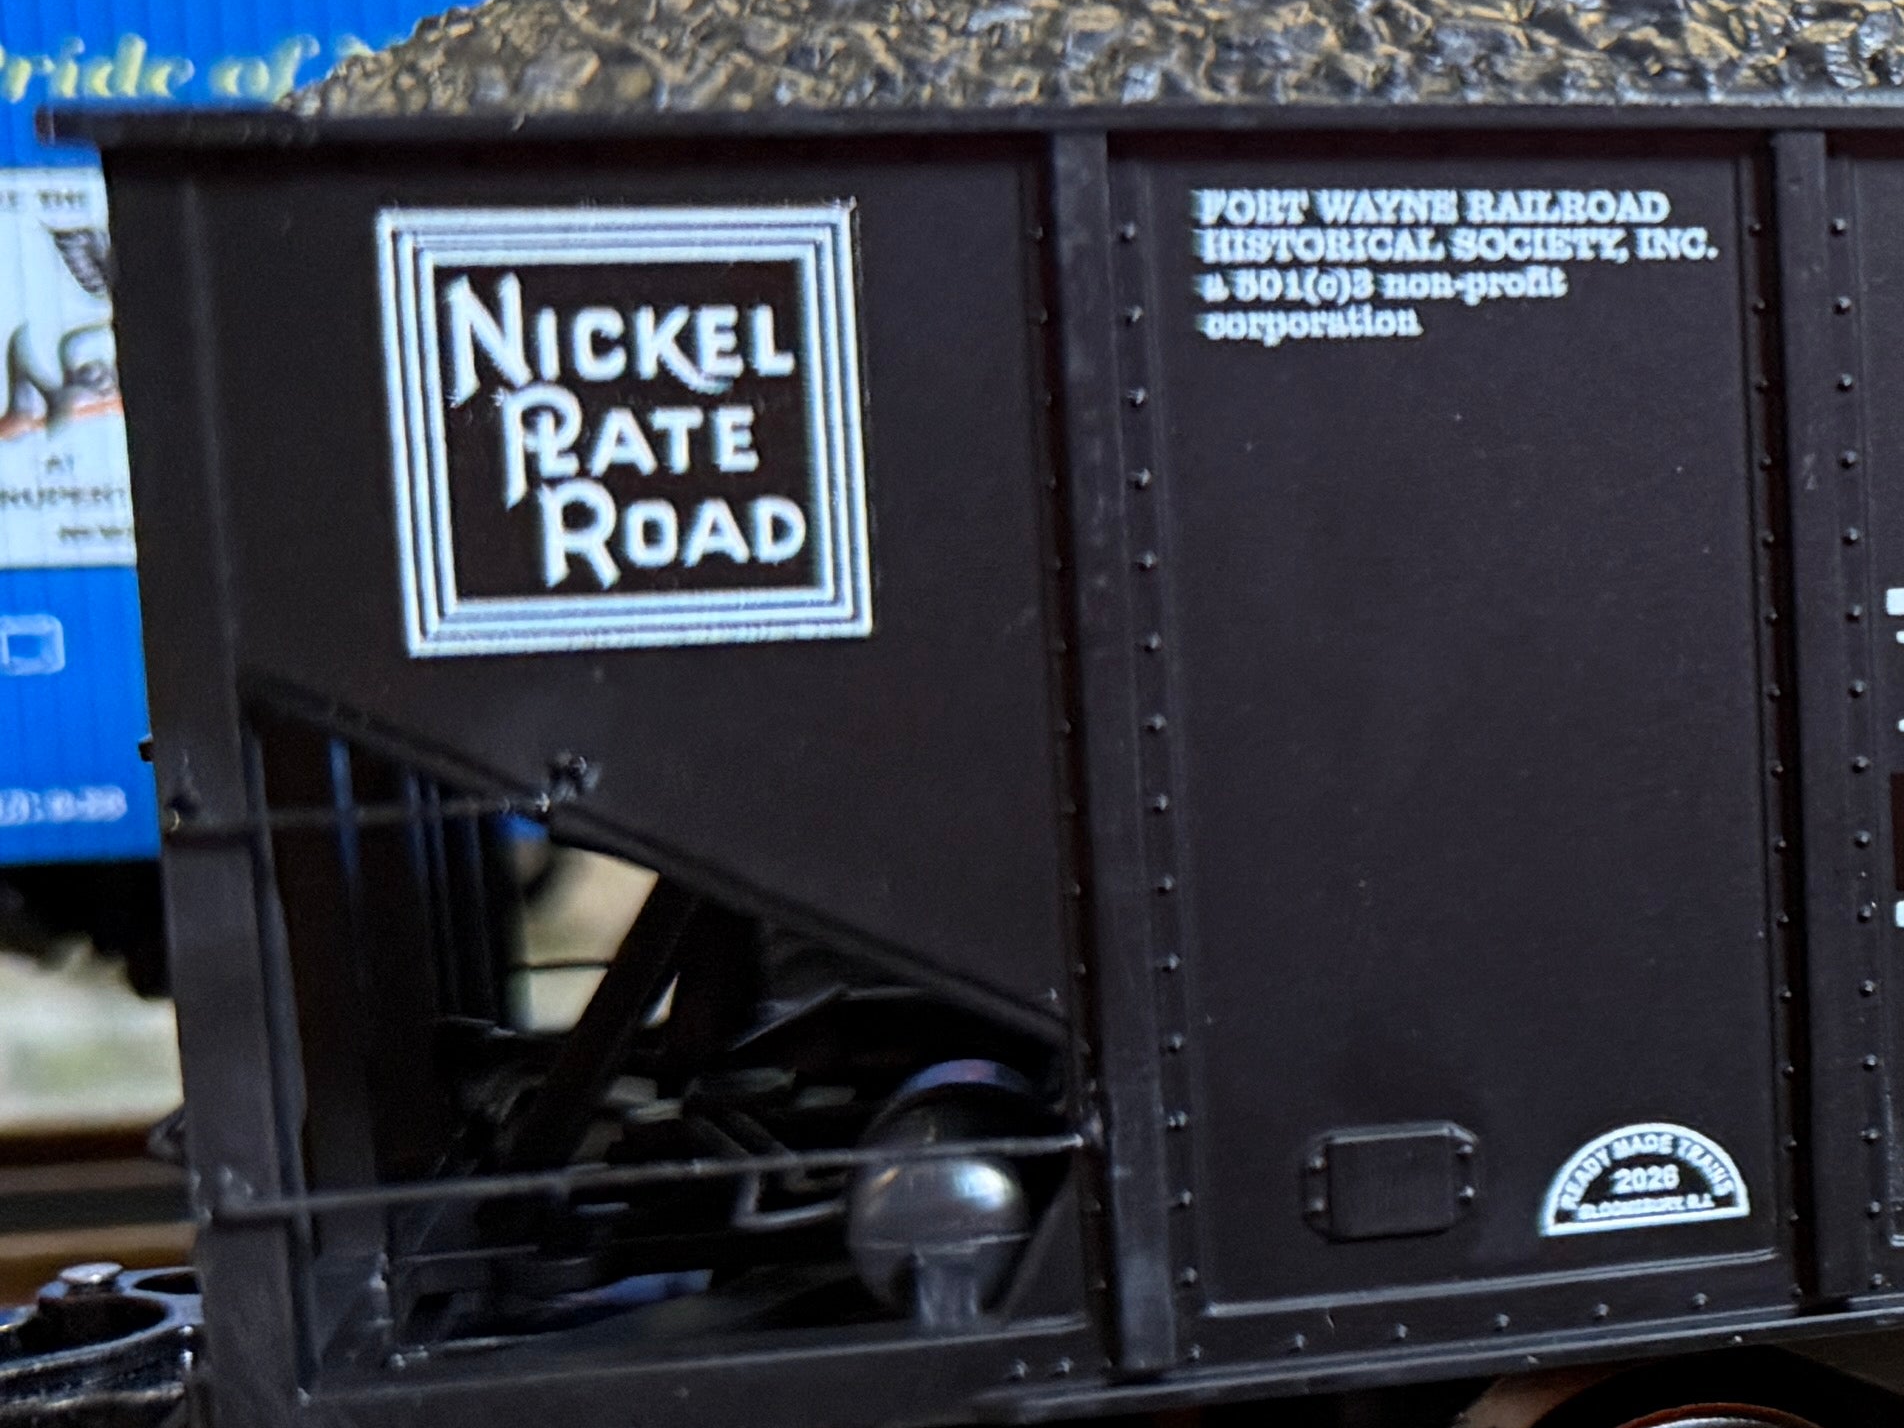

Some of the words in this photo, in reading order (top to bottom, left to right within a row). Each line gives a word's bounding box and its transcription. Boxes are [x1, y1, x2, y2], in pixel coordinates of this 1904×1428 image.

[0, 33, 195, 103] ride
[1195, 189, 1310, 225] FORT
[1315, 189, 1459, 224] WAYNE
[1464, 189, 1671, 224] RAILROAD
[1195, 227, 1446, 263] HISTORICAL
[1448, 227, 1630, 264] SOCIETY,
[1636, 227, 1718, 260] INC.
[1379, 265, 1568, 306] non-profit
[444, 272, 796, 408] NICKEL
[1197, 303, 1424, 347] corporation
[504, 380, 760, 511] PLATE
[540, 478, 807, 590] ROAD
[1612, 1133, 1674, 1160] MADE
